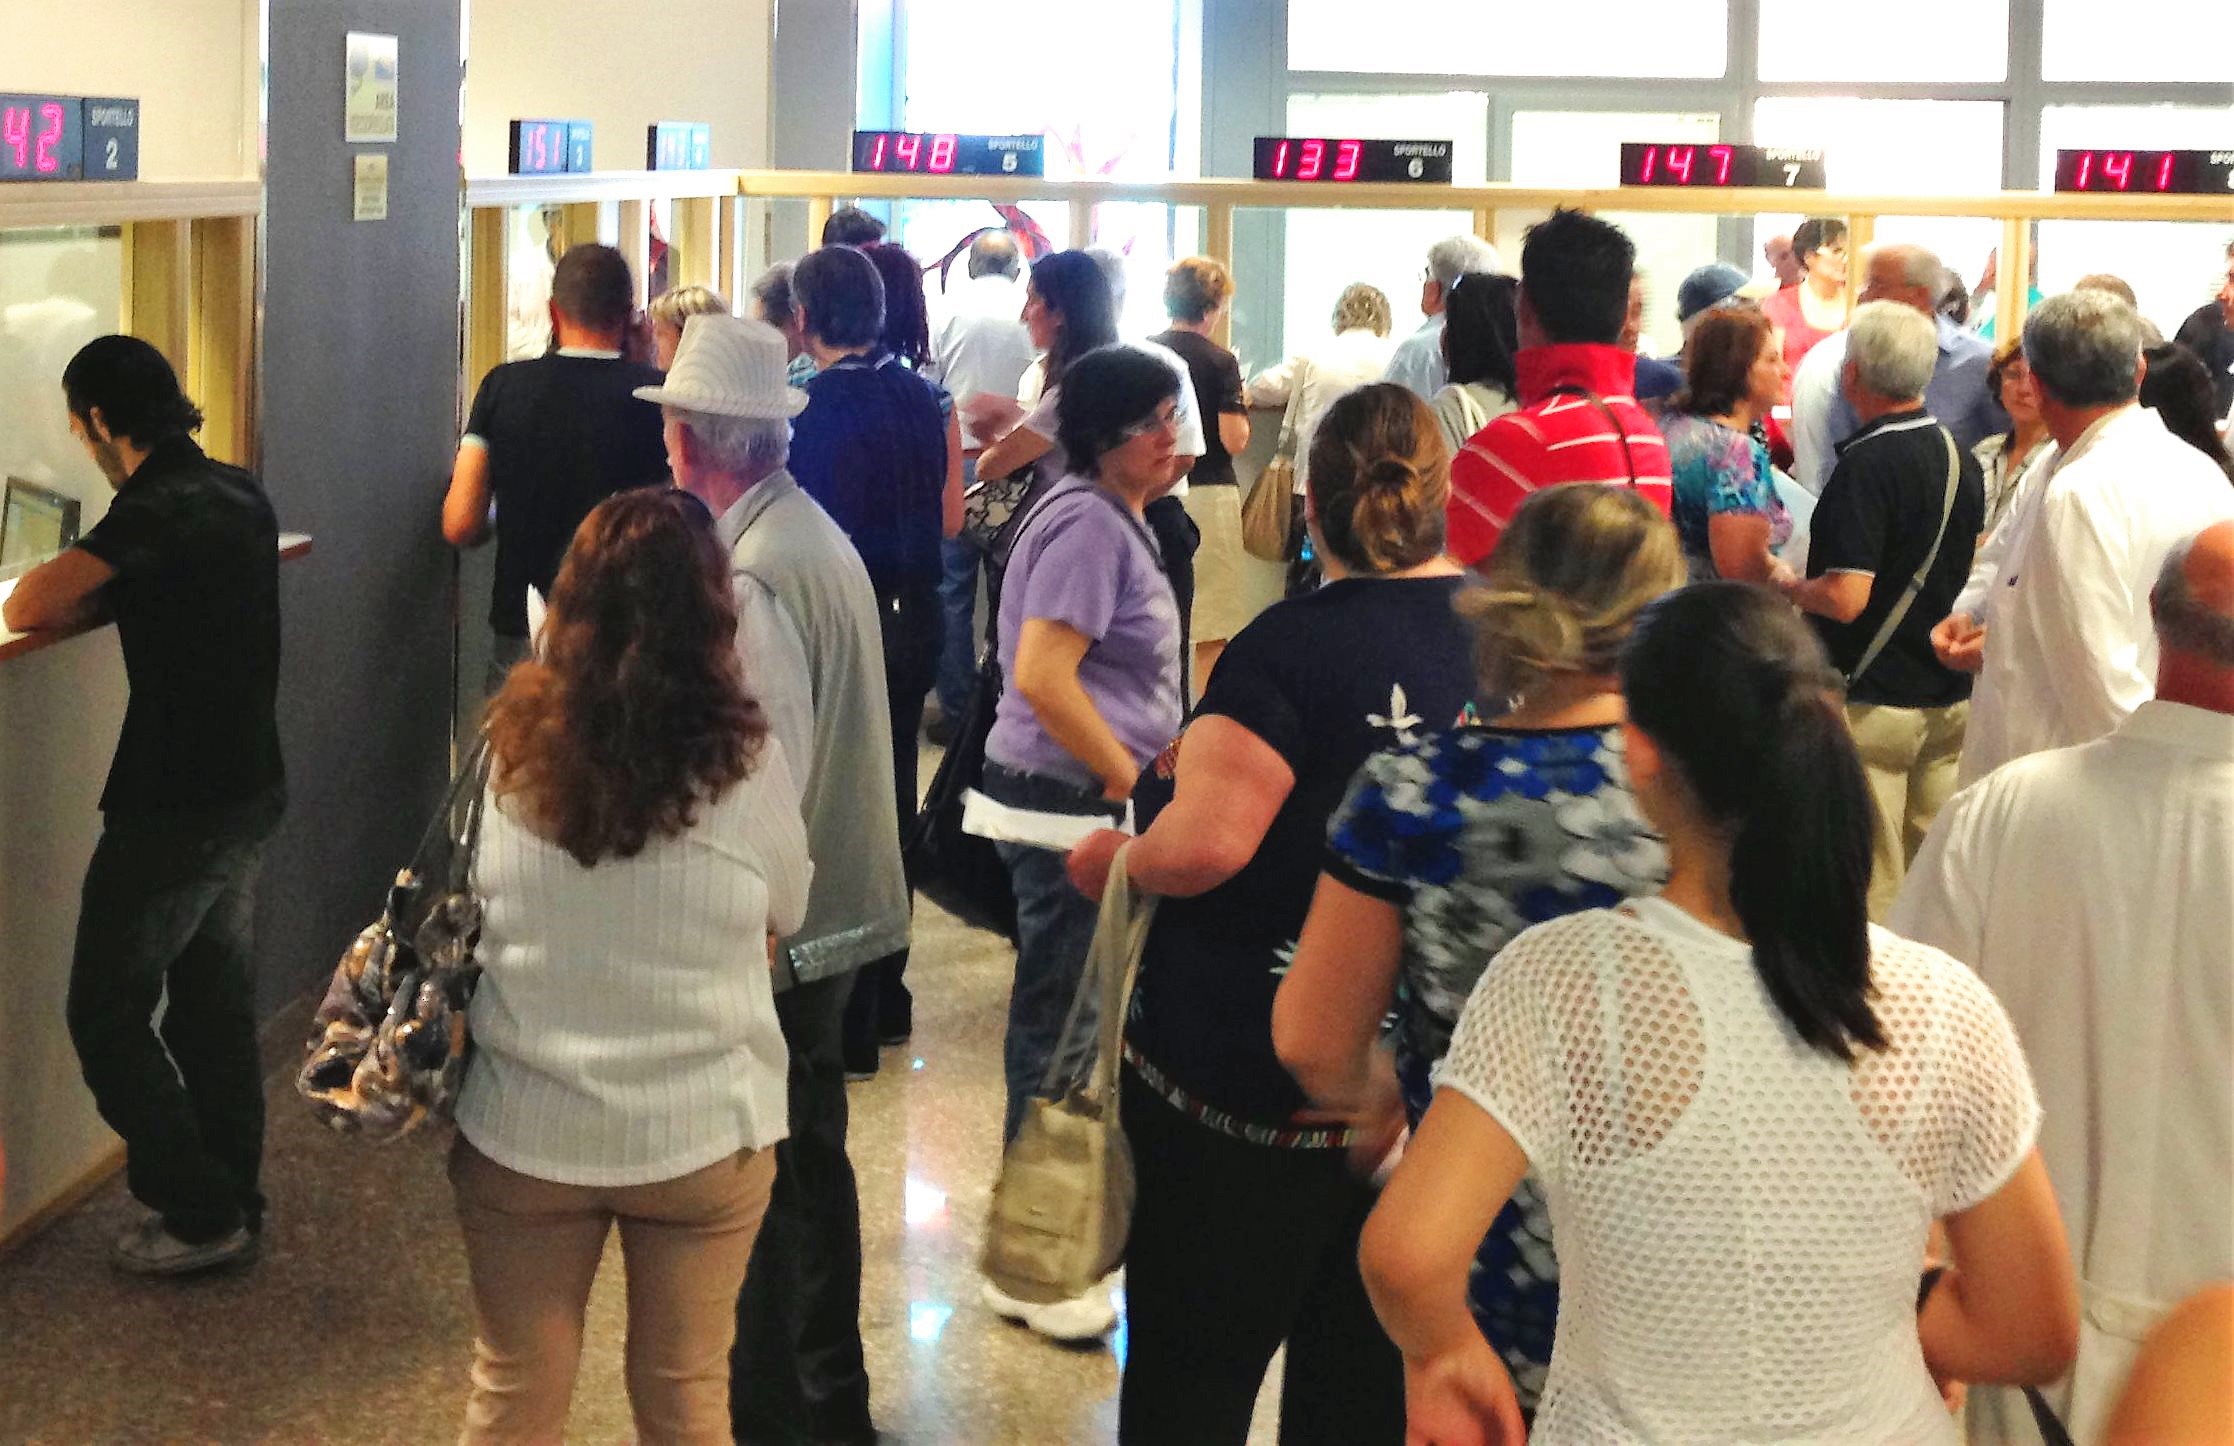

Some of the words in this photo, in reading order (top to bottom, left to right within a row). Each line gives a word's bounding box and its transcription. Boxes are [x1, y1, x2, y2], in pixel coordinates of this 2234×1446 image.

[3, 103, 63, 172] 42
[105, 136, 119, 170] 2
[527, 123, 562, 171] 151
[872, 134, 957, 173] 148
[988, 137, 1038, 151] SPORTELLO
[1394, 143, 1447, 157] SPORTELLO
[1274, 139, 1363, 180] 133
[1408, 157, 1424, 179] 6
[1641, 144, 1733, 184] 147
[1783, 162, 1802, 187] 7
[2076, 151, 2173, 189] 141
